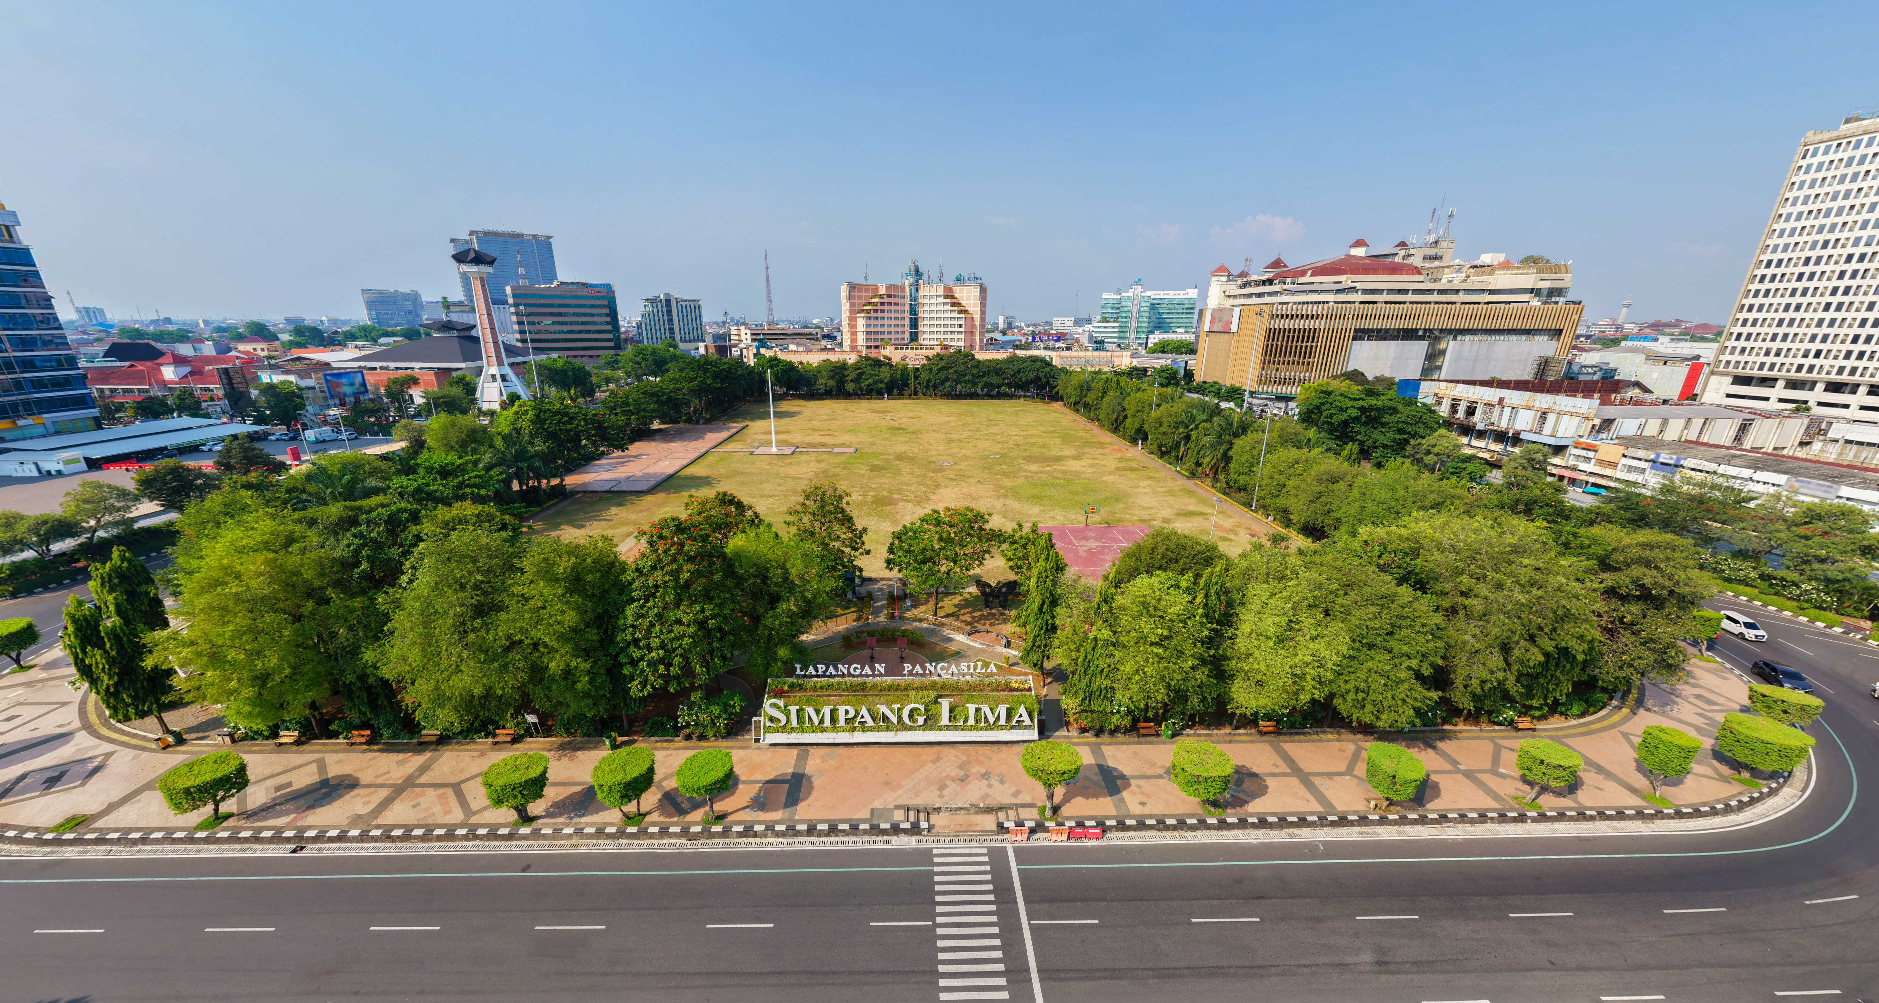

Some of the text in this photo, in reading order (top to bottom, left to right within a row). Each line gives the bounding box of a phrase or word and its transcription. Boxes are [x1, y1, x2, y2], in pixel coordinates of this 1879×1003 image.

[795, 661, 998, 675] LAPANGAN PANCASILA
[764, 698, 1033, 727] SIMPANG LIMA
